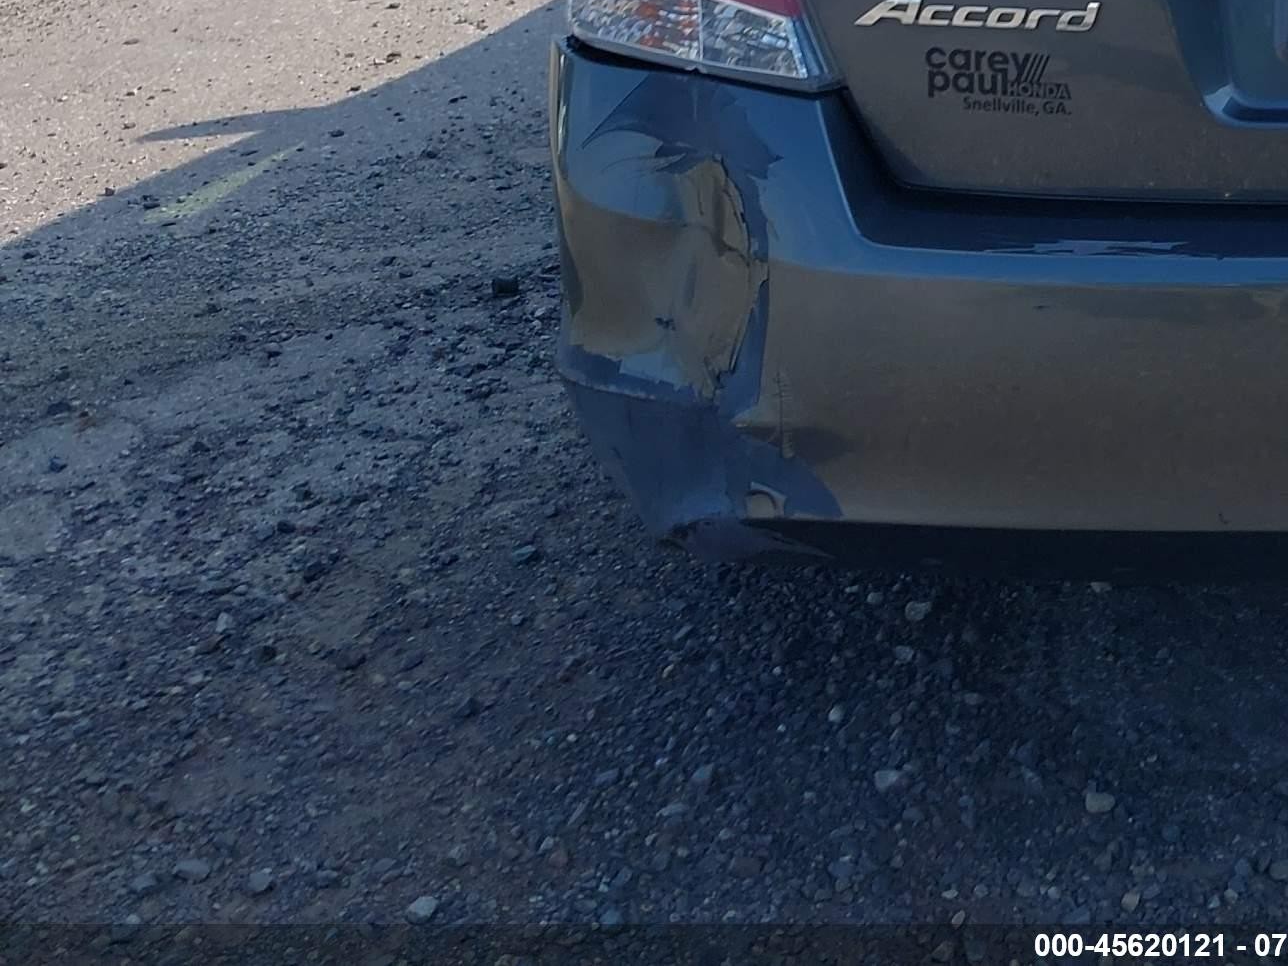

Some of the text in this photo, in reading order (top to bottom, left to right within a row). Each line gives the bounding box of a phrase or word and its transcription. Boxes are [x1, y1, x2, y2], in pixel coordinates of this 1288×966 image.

[925, 46, 1031, 83] carey
[927, 68, 1072, 99] paul HONDA
[963, 97, 1073, 116] Snellville, GA.
